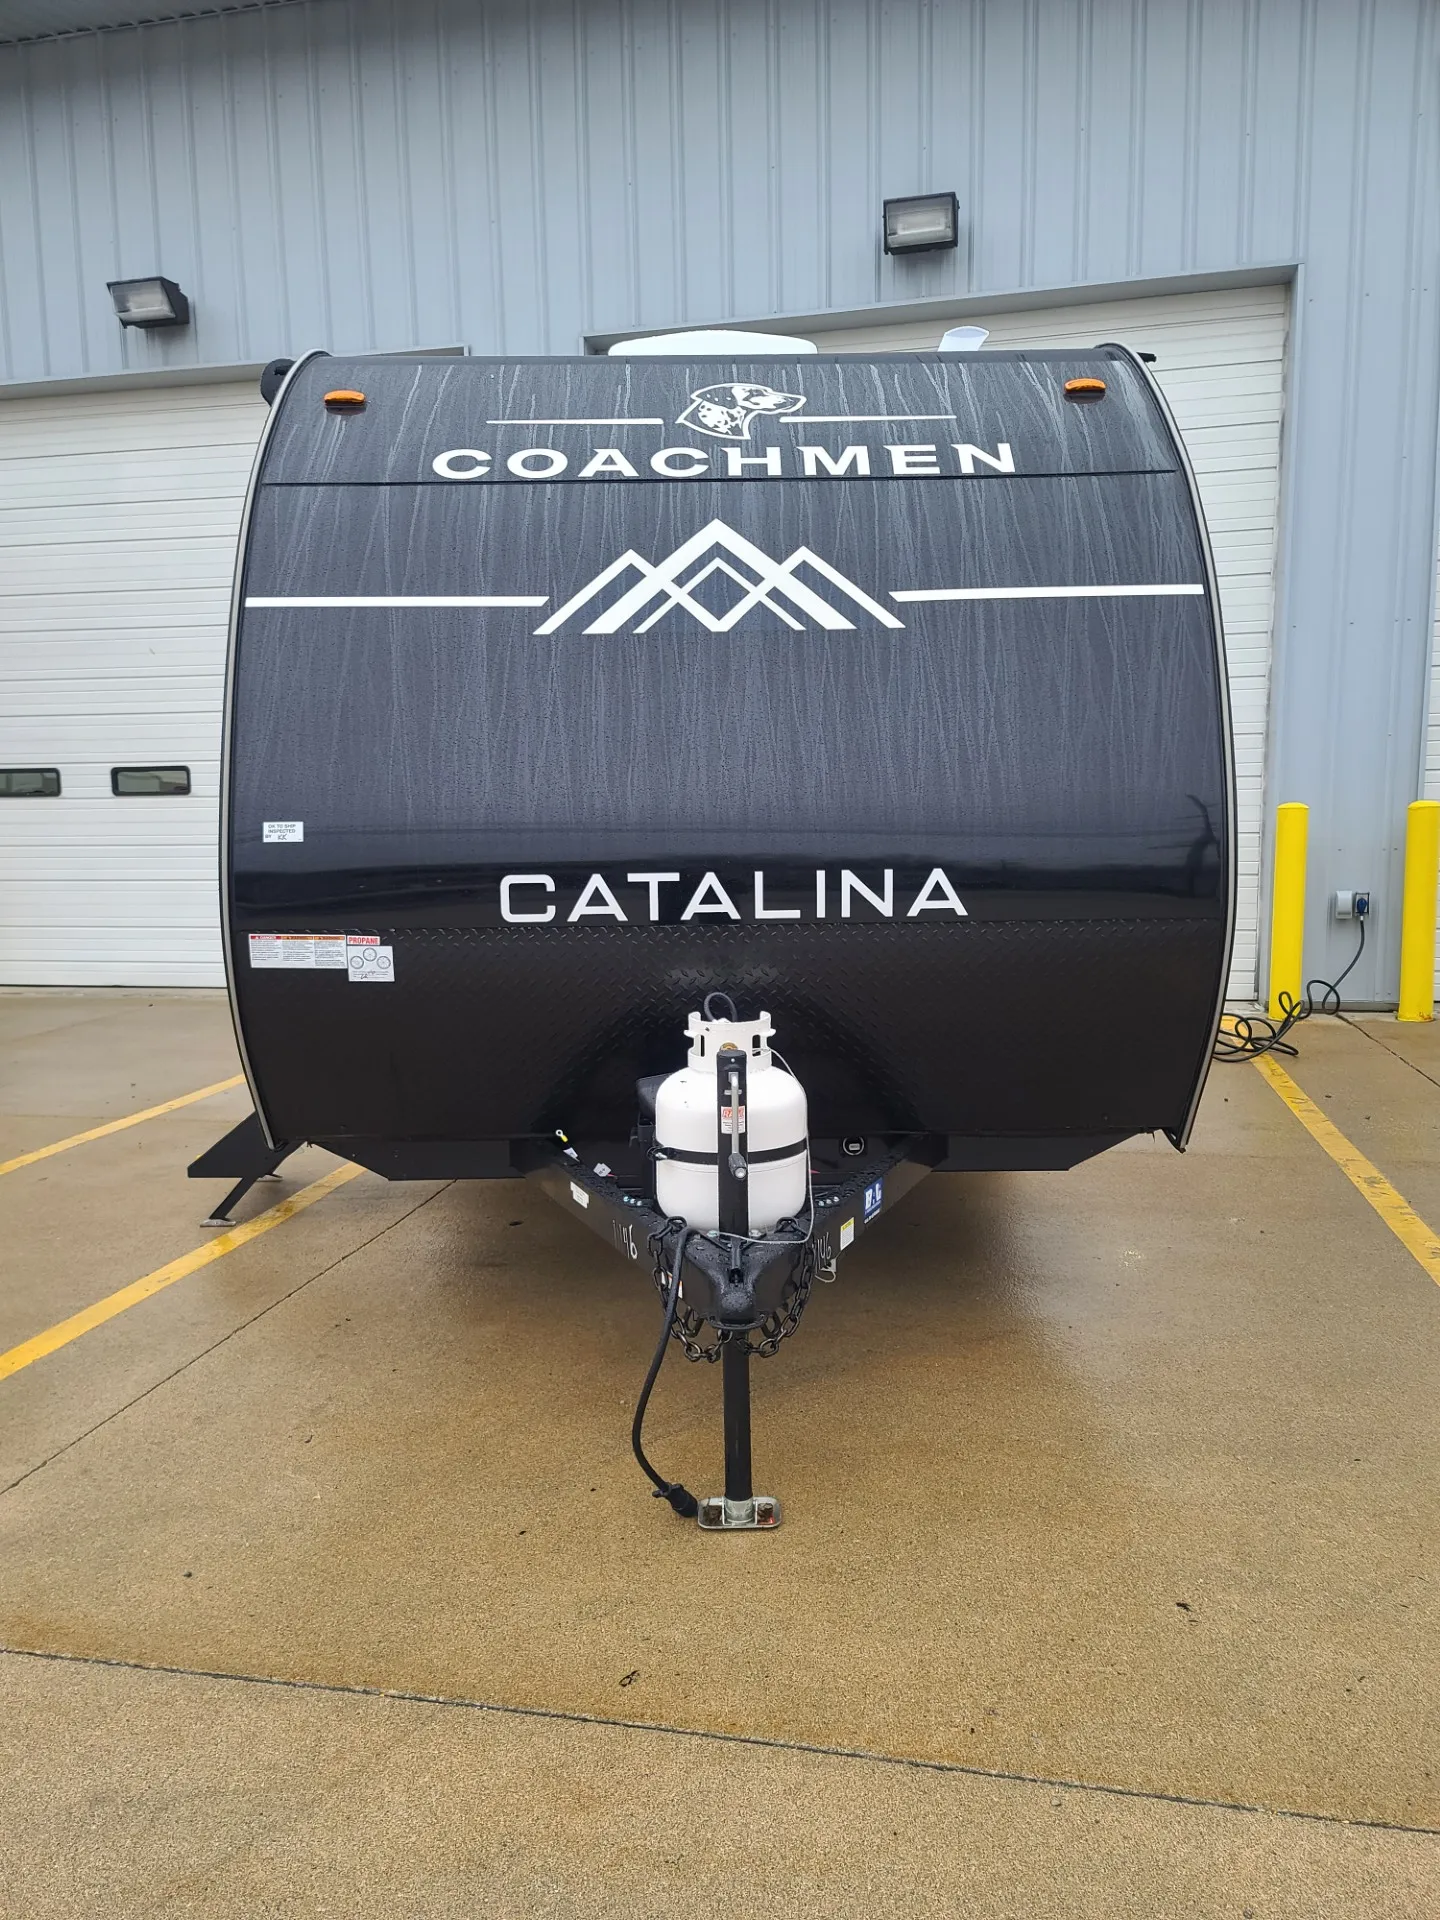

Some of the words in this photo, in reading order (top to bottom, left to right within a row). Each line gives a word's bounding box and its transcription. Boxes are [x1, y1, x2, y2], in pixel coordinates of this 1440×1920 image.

[432, 443, 1016, 480] COACHMEN
[500, 868, 969, 923] CATALINA
[348, 937, 379, 945] PROPANE
